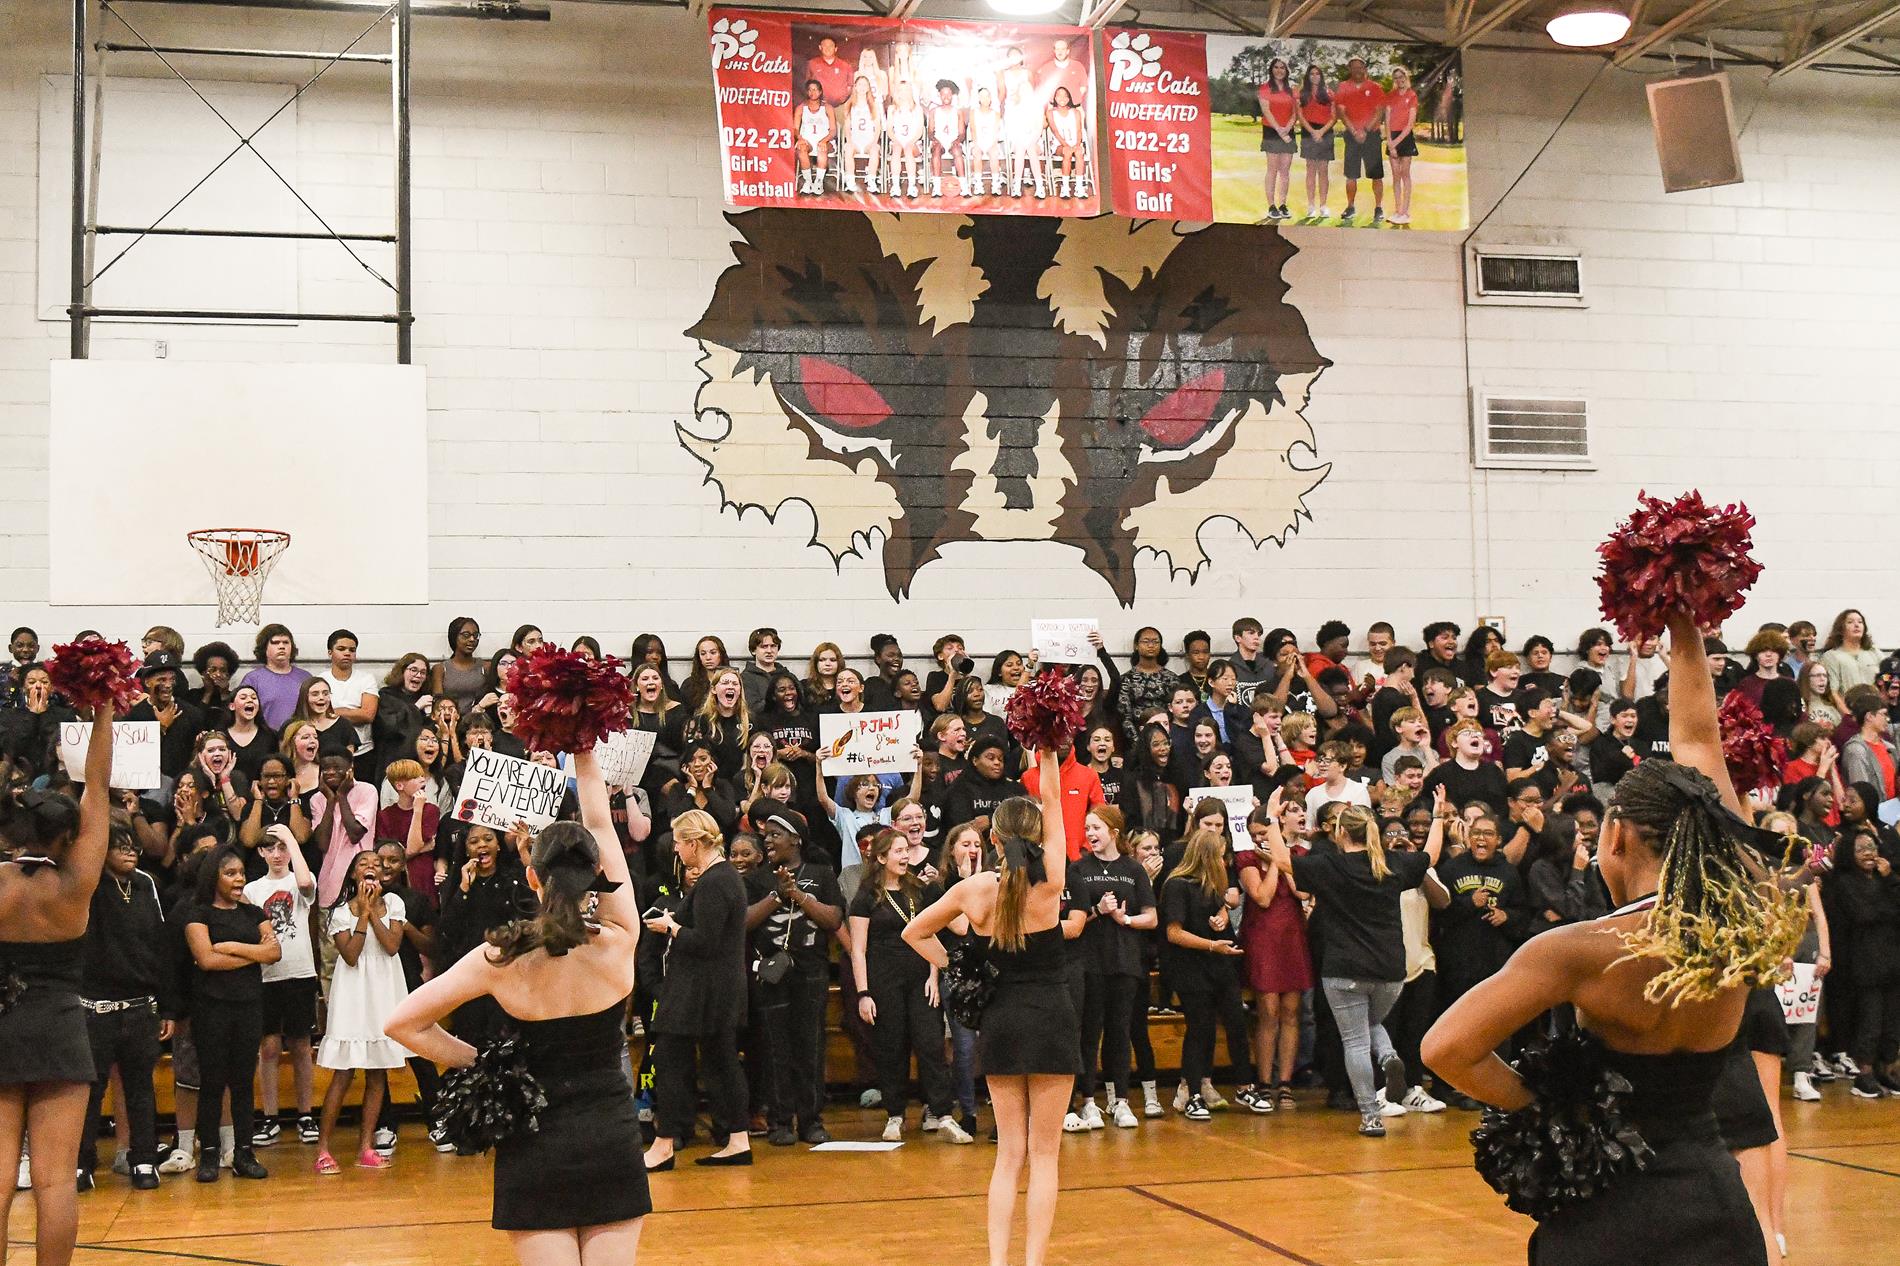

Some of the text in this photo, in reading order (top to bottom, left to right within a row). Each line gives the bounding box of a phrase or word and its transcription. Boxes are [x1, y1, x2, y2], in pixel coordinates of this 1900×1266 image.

[725, 60, 750, 70] JHS
[752, 51, 791, 73] Cats
[1125, 81, 1155, 93] JHS
[1157, 70, 1201, 96] Cats
[719, 86, 790, 107] NDEFEATED
[1110, 101, 1198, 122] UNDEFEATED
[723, 126, 792, 149] 022-23
[1114, 129, 1190, 153] 2022-23
[731, 180, 794, 197] sketball
[1136, 191, 1173, 212] Golf
[468, 749, 567, 796] YOU ARE NOW
[473, 777, 563, 818] ENTERING
